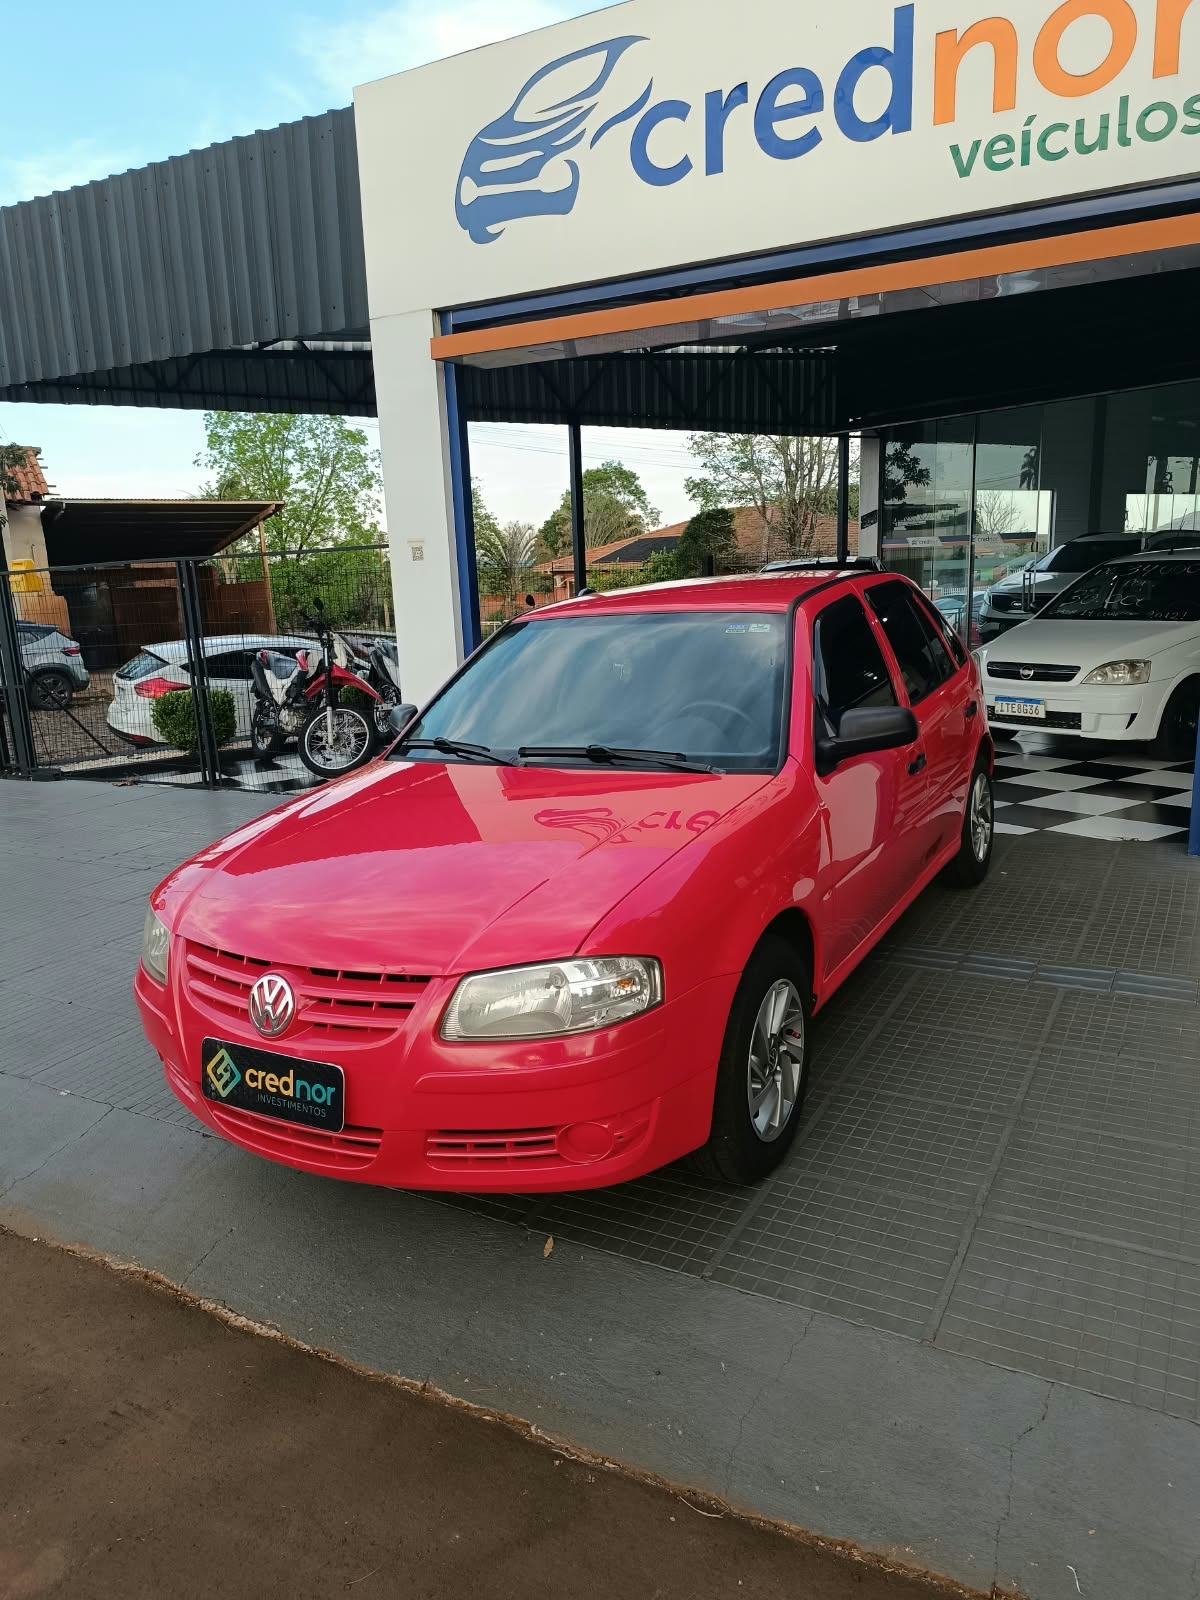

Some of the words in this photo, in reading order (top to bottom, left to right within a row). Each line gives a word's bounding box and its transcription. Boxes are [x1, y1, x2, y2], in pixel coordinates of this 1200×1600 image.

[630, 0, 1200, 187] crednor
[949, 94, 1200, 179] veículos
[1000, 702, 1040, 716] ITE8G36
[245, 1068, 336, 1106] crednor
[257, 1093, 327, 1118] INVESTIMENTOS
